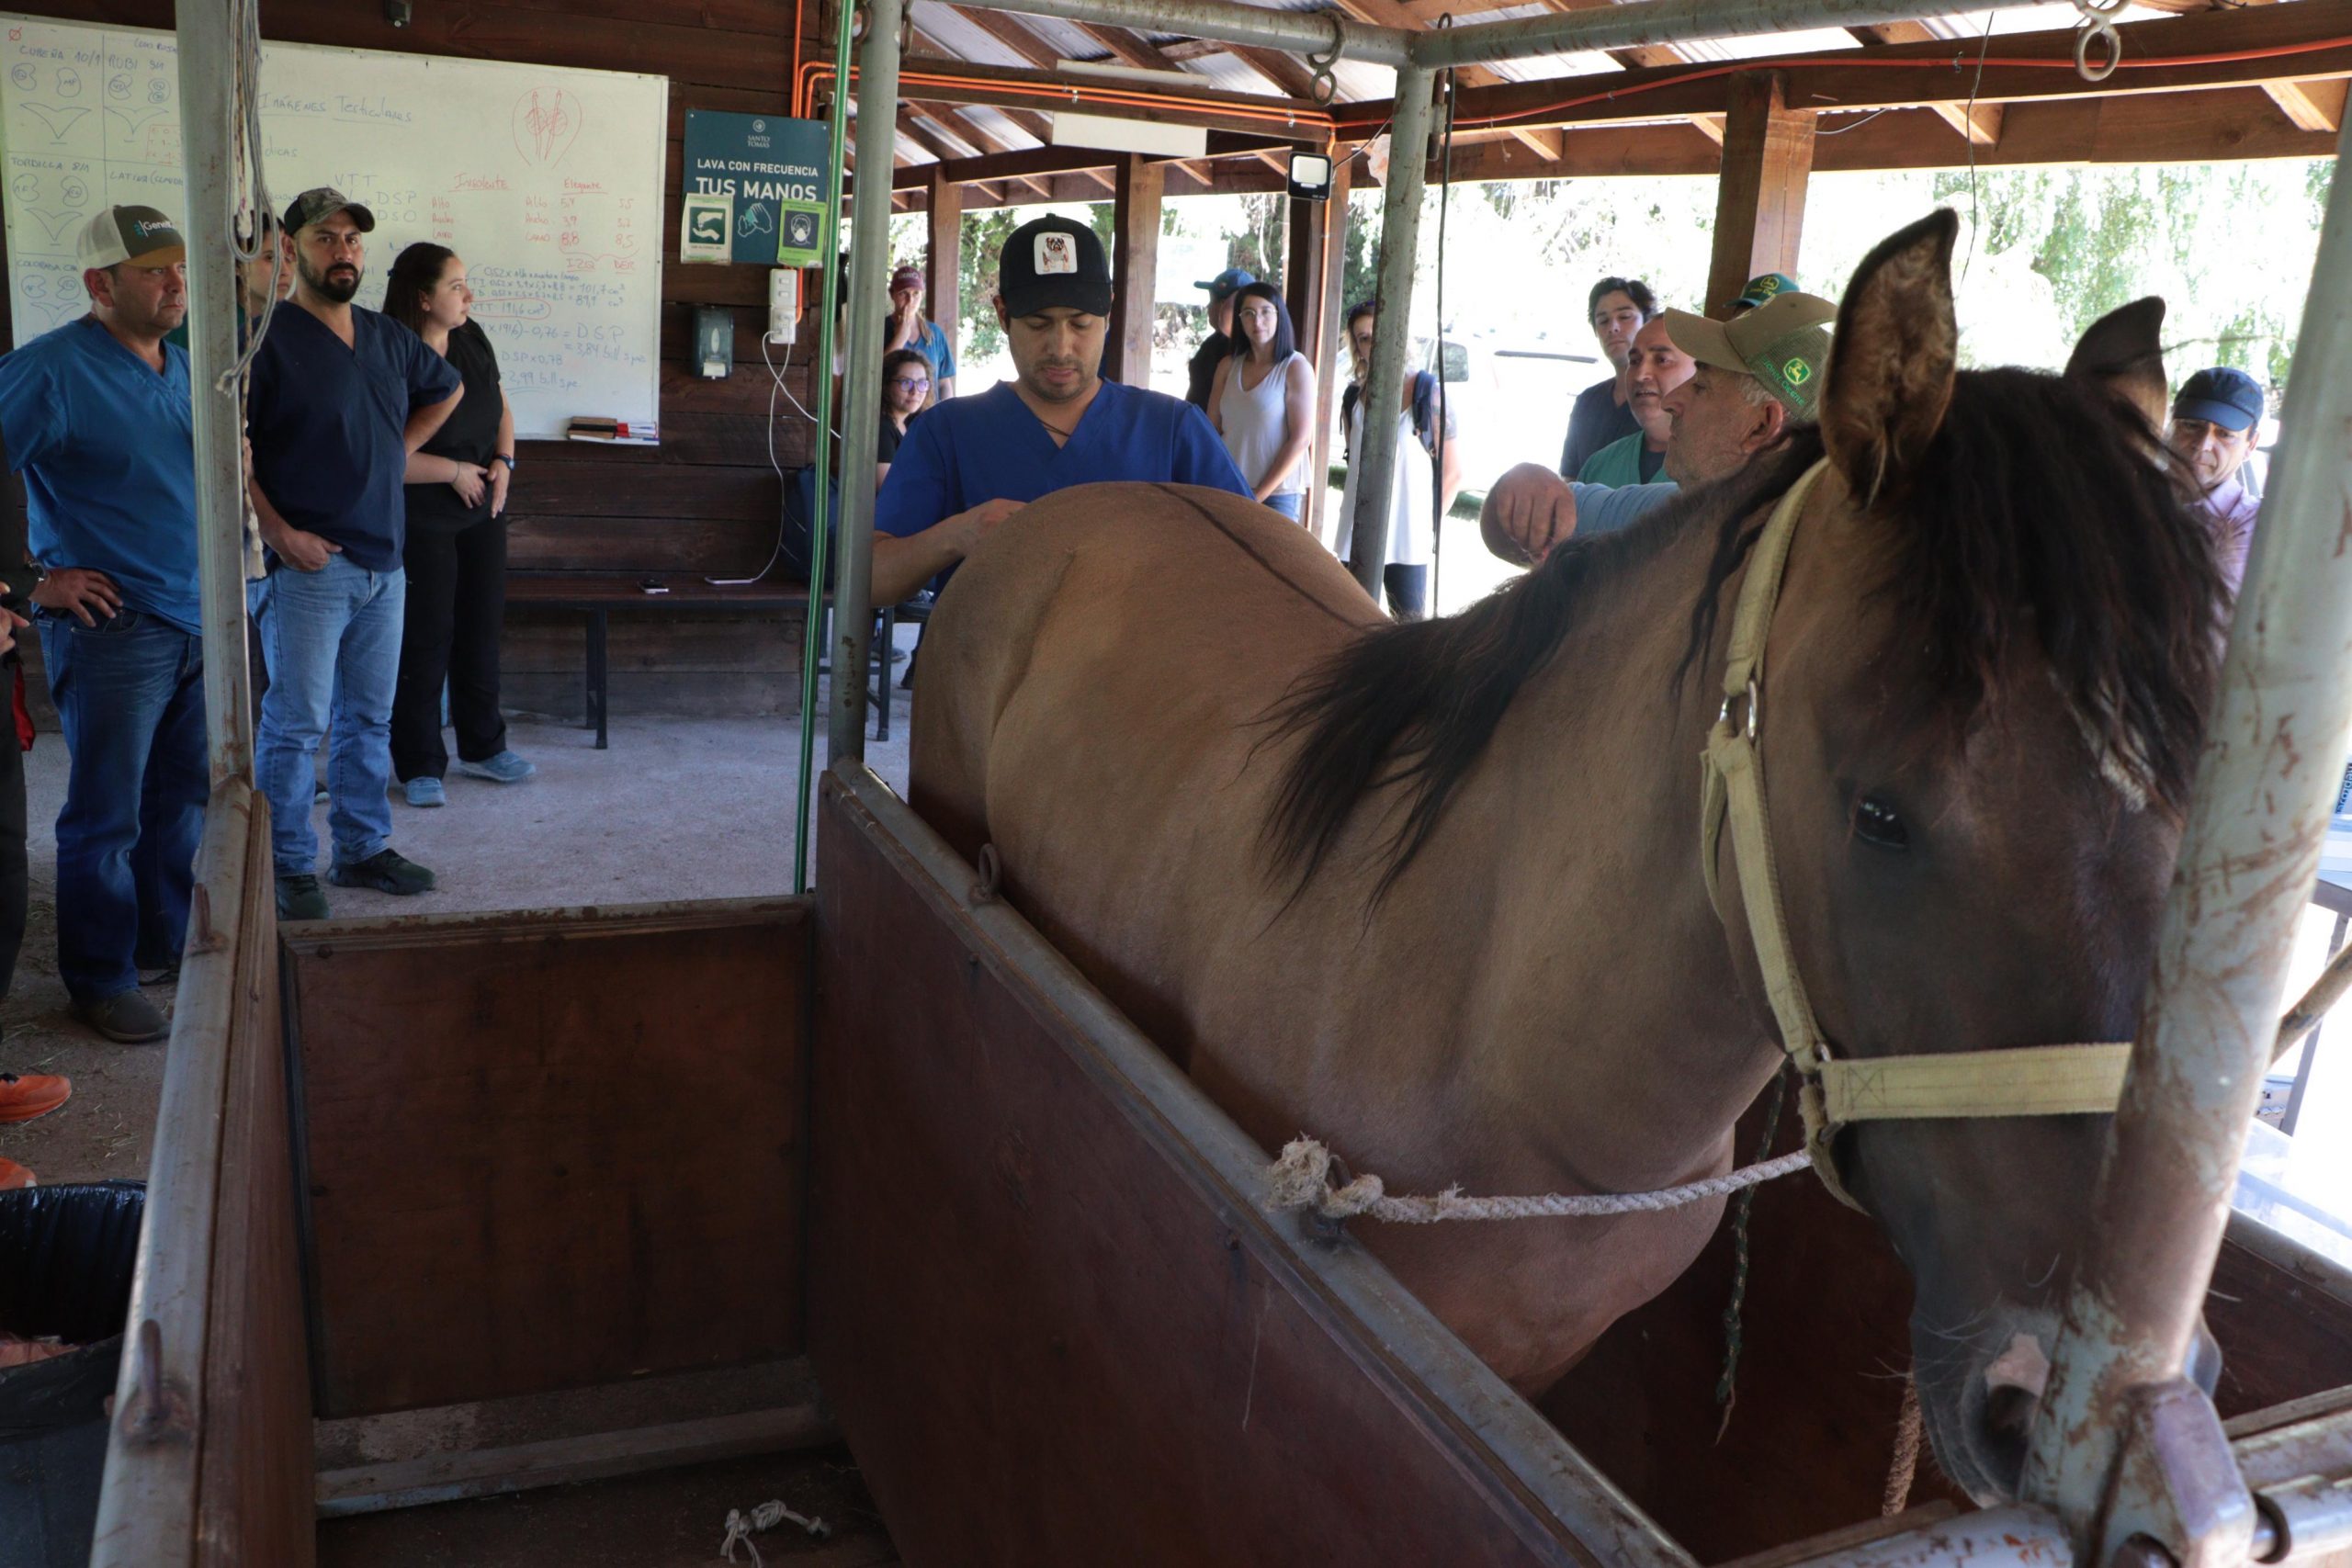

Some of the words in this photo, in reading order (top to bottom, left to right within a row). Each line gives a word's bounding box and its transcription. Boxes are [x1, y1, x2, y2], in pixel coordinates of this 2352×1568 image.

[748, 134, 770, 142] SANTO
[697, 158, 726, 170] LAVA
[729, 161, 751, 172] CON
[753, 163, 819, 177] FRECUENCIA
[695, 177, 736, 196] TUS
[743, 180, 817, 201] MANOS
